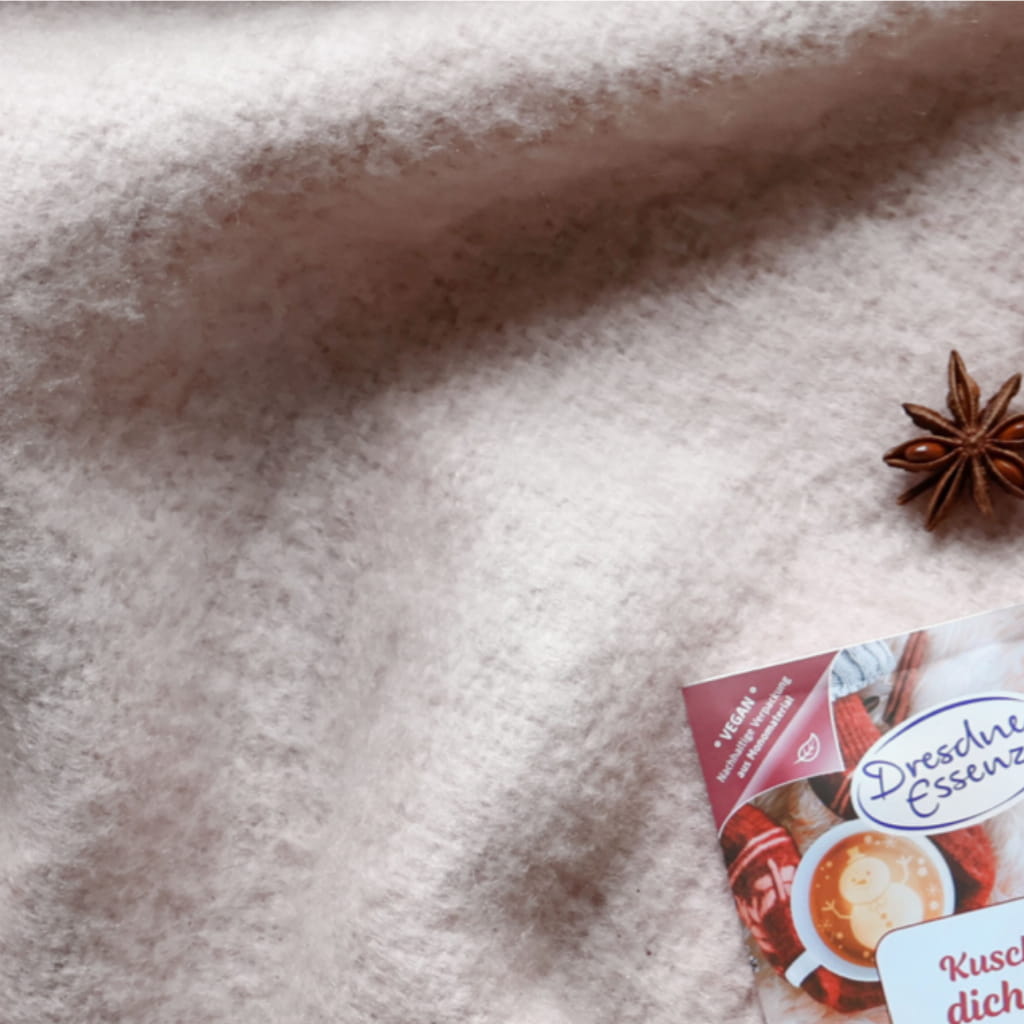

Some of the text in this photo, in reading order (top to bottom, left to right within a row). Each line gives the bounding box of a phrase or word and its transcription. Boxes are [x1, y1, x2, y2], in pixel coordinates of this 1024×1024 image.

[716, 676, 792, 783] Nachhaltige Verpackung
[719, 695, 756, 740] VEGAN
[737, 695, 794, 779] aus Monomaterial
